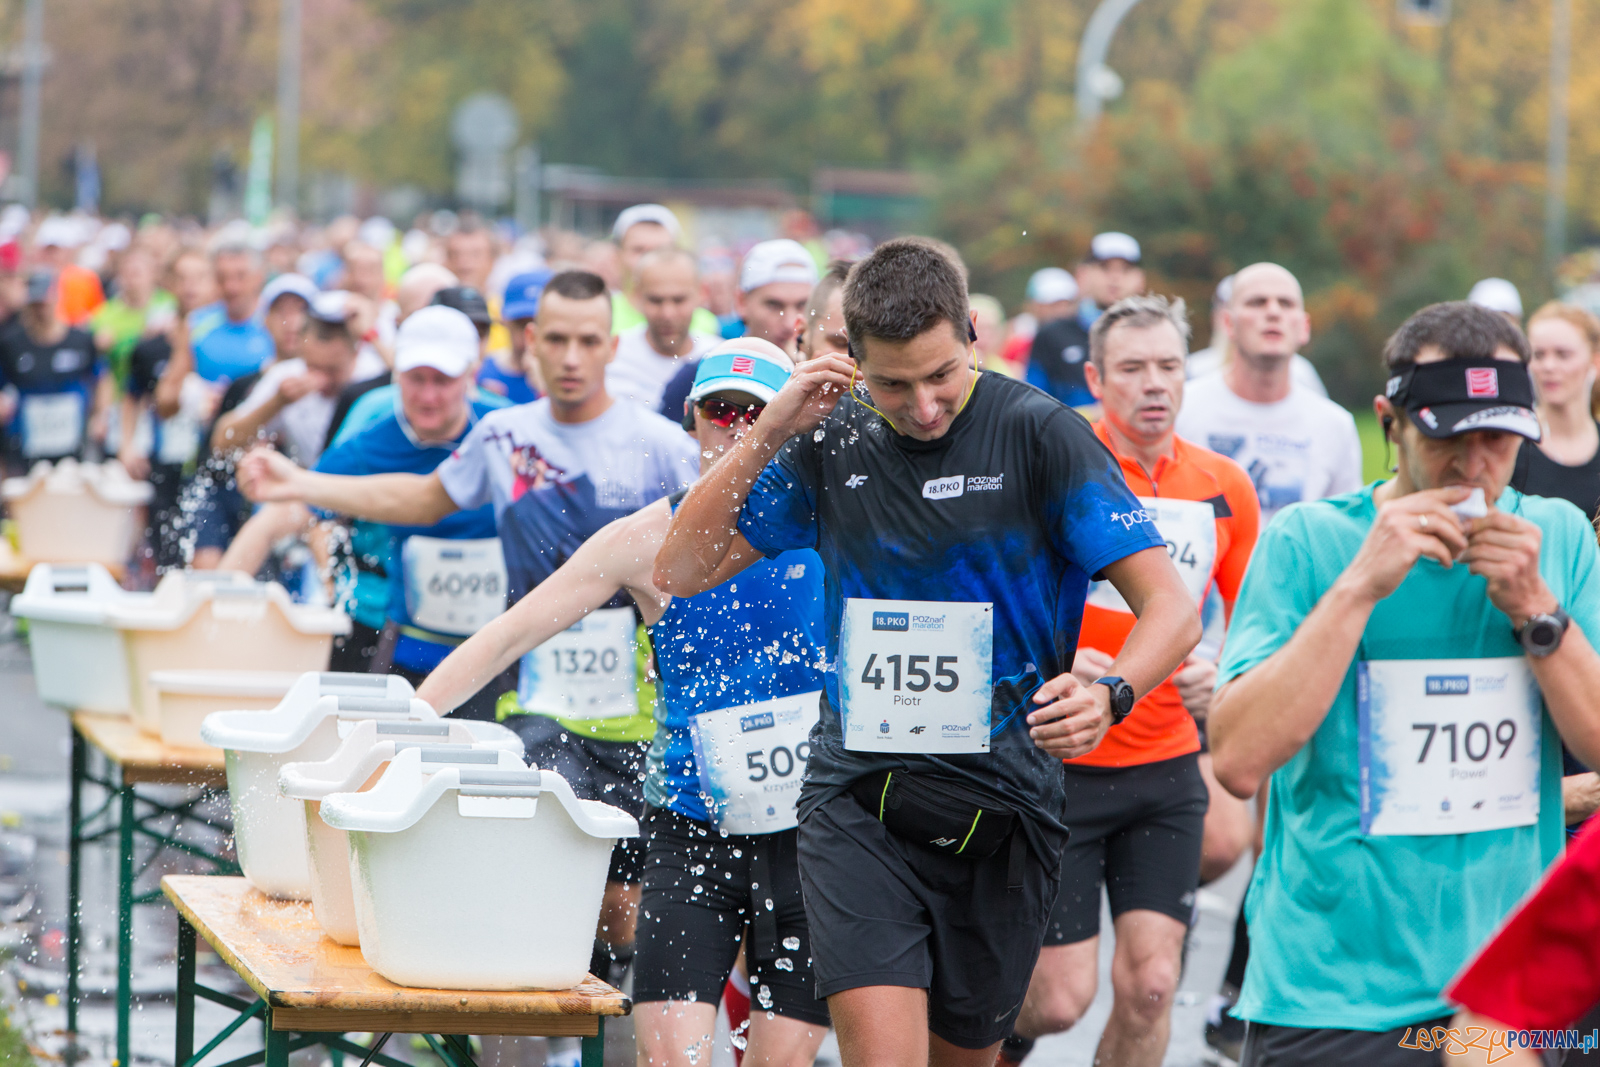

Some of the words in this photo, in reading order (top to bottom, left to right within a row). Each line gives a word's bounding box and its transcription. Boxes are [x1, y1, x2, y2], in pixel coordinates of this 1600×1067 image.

[966, 483, 1003, 491] maraton
[428, 570, 500, 597] 6098
[552, 647, 619, 674] 1320
[861, 653, 960, 693] 4155
[893, 694, 922, 706] Piotr
[909, 725, 926, 735] 4F
[1411, 719, 1517, 763] 7109
